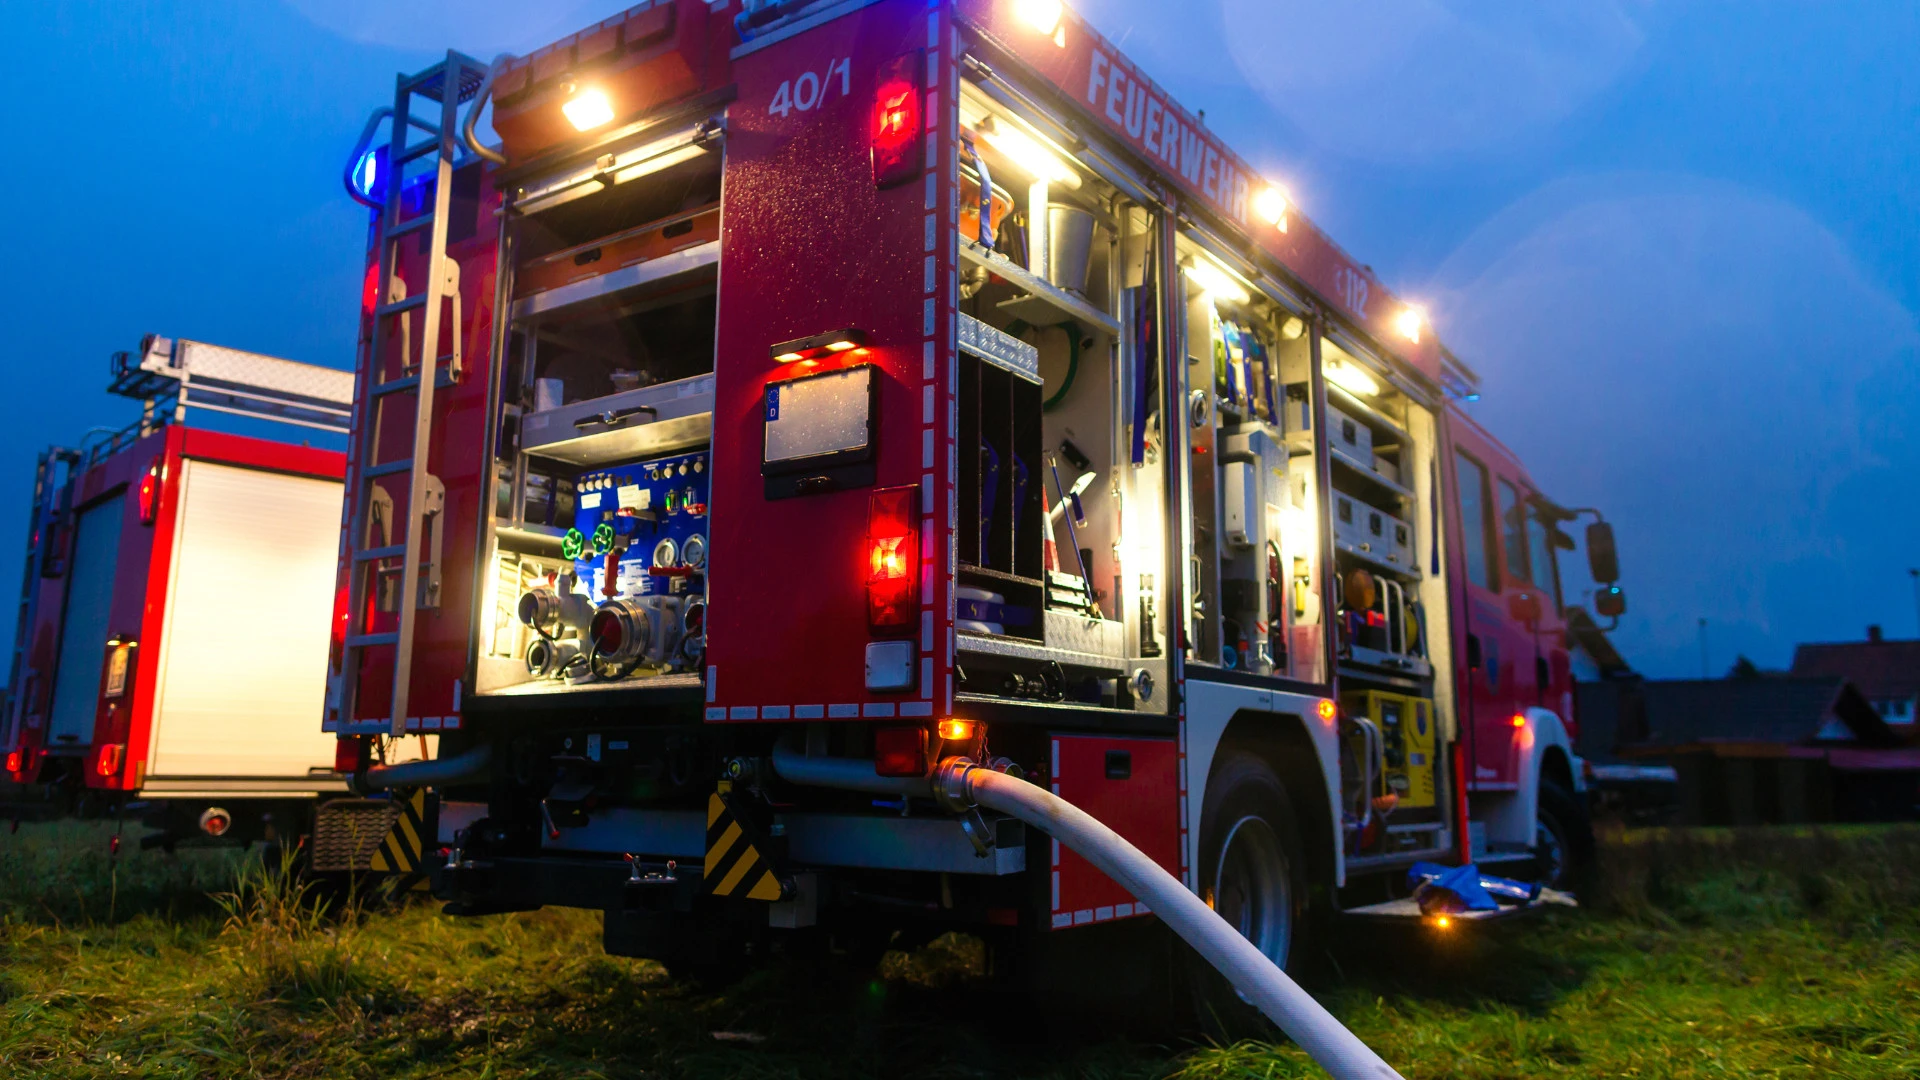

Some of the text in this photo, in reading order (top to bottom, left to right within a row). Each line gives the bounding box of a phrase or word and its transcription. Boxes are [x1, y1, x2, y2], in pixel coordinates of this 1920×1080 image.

[768, 57, 851, 117] 40/1
[1087, 48, 1250, 225] FEUERWEHR
[1345, 267, 1368, 320] 112
[770, 408, 776, 417] D
